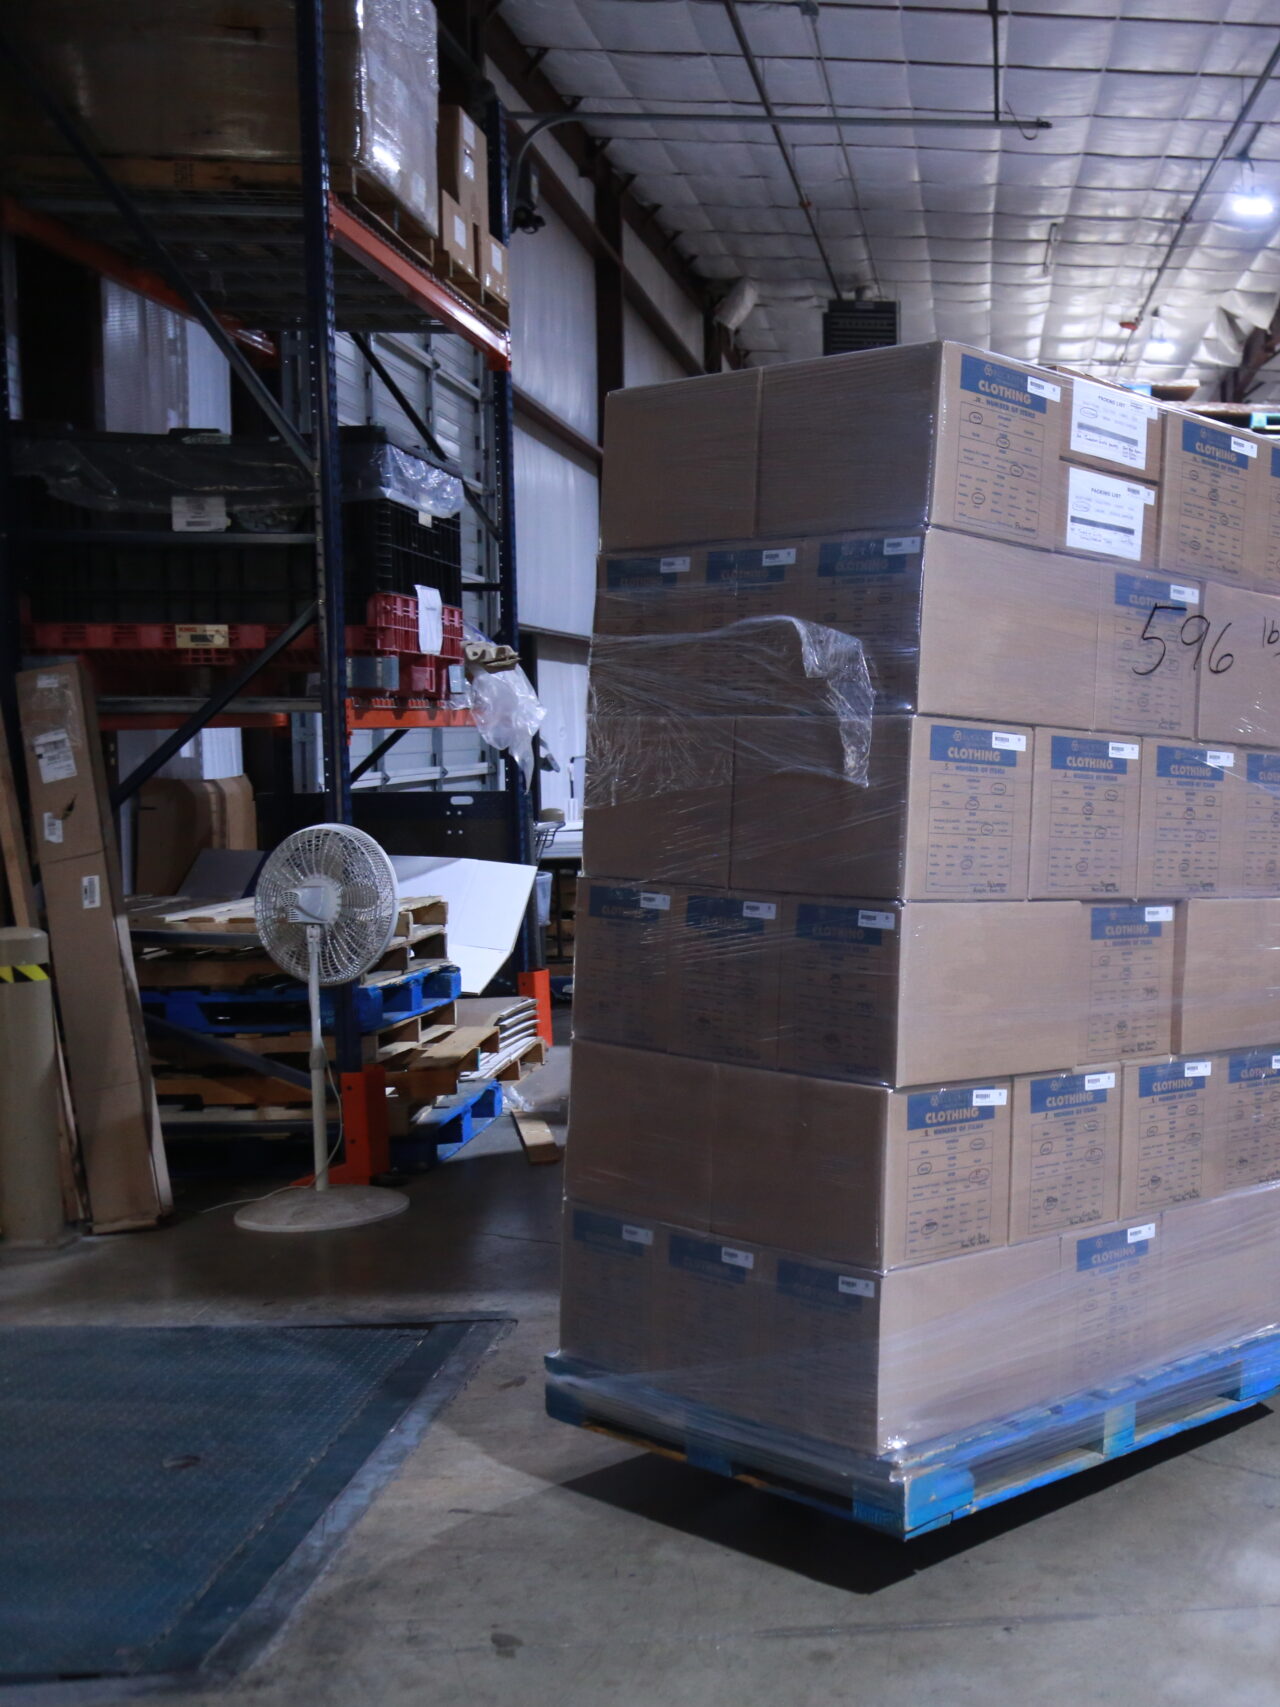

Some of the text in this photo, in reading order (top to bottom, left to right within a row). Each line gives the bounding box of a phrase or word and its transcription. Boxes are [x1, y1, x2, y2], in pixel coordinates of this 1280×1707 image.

[978, 380, 1032, 404] CLOTHING
[986, 400, 1009, 410] NUMBER
[1098, 395, 1116, 405] PACKING
[1195, 442, 1237, 462] CLOTHING
[1091, 487, 1111, 497] PACKING
[835, 558, 888, 572] CLOTHING
[1132, 603, 1234, 676] 596
[947, 747, 1001, 761] CLOTHING
[1066, 756, 1113, 769] CLOTHING
[1170, 765, 1212, 777] CLOTHING
[812, 925, 865, 940] CLOTHING
[1105, 924, 1149, 935] CLOTHING
[1240, 1068, 1277, 1079] CLOTHING
[1152, 1078, 1193, 1092] CLOTHING
[1046, 1092, 1094, 1107] CLOTHING
[925, 1107, 979, 1124] CLOTHING
[933, 1127, 957, 1136] NUMBER
[1091, 1246, 1136, 1264] CLOTHING
